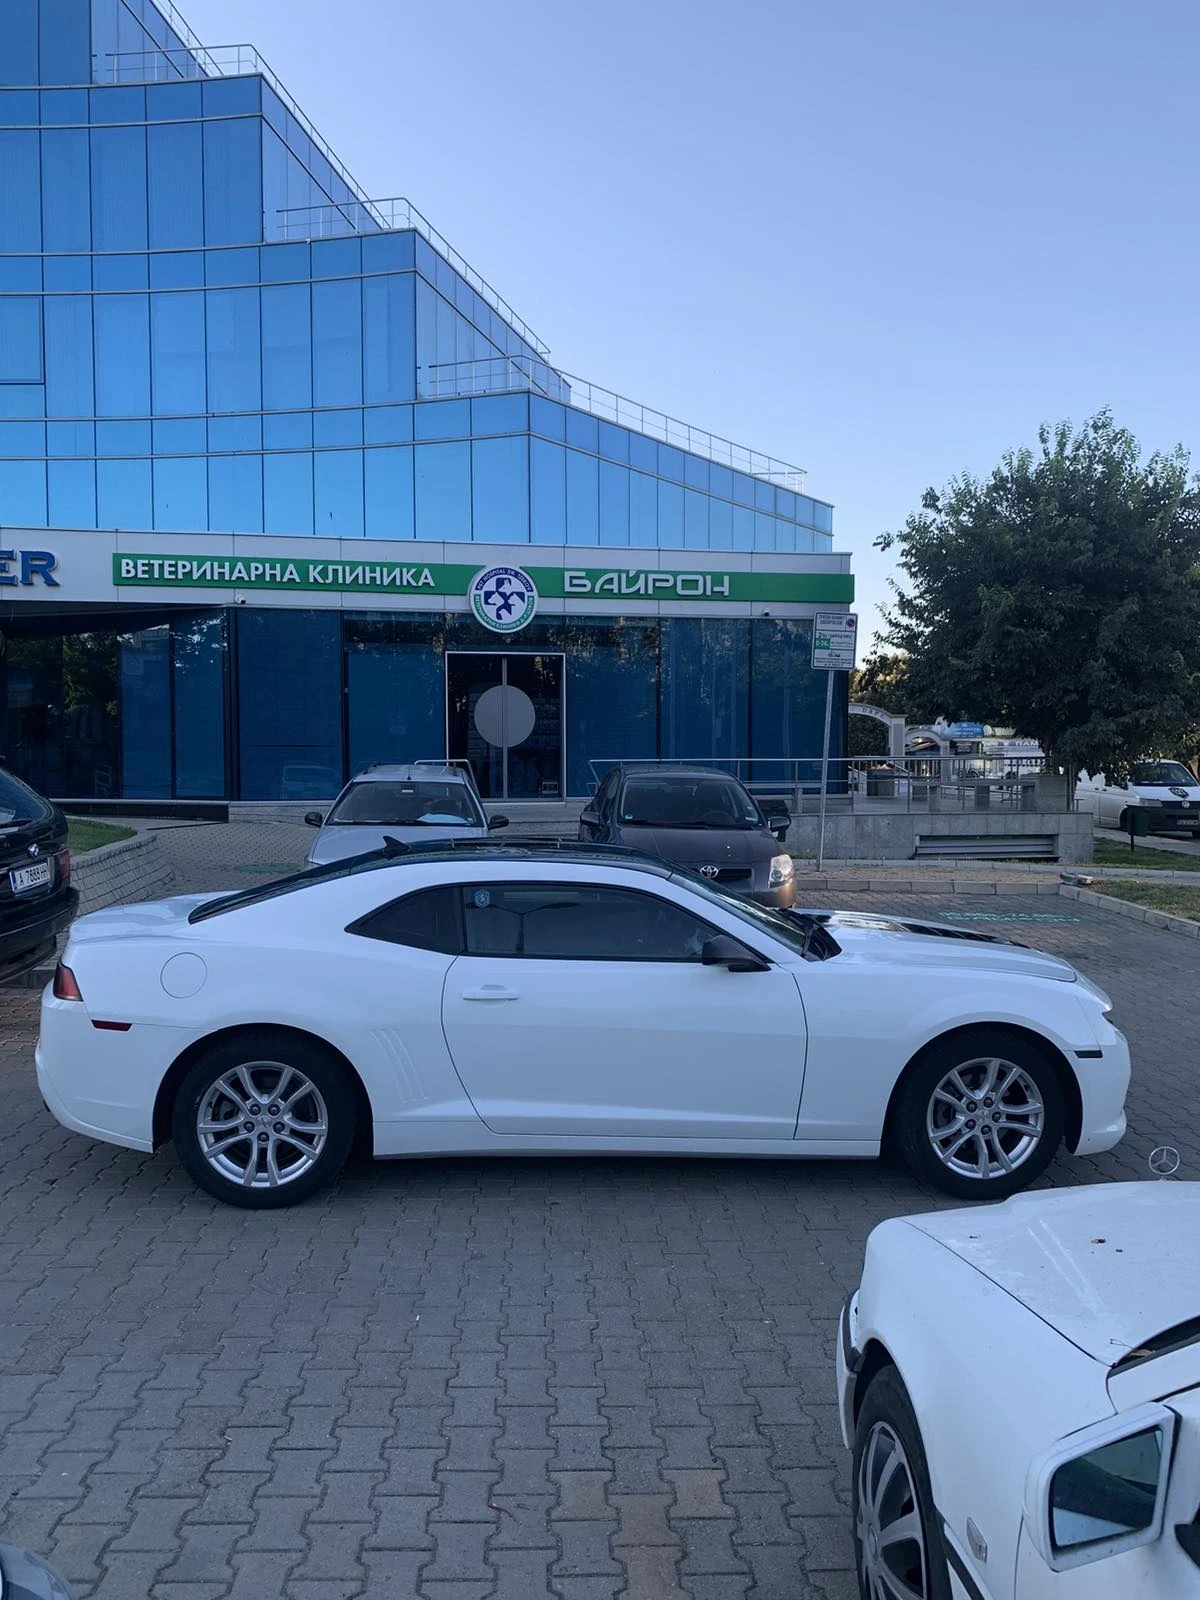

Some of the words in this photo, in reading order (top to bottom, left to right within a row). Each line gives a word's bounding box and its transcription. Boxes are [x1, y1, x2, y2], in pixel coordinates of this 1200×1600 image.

[121, 559, 301, 583] ВЕТЕРИНАРНА
[308, 564, 436, 587] КЛИНИКА
[564, 570, 730, 596] БАЙРОН
